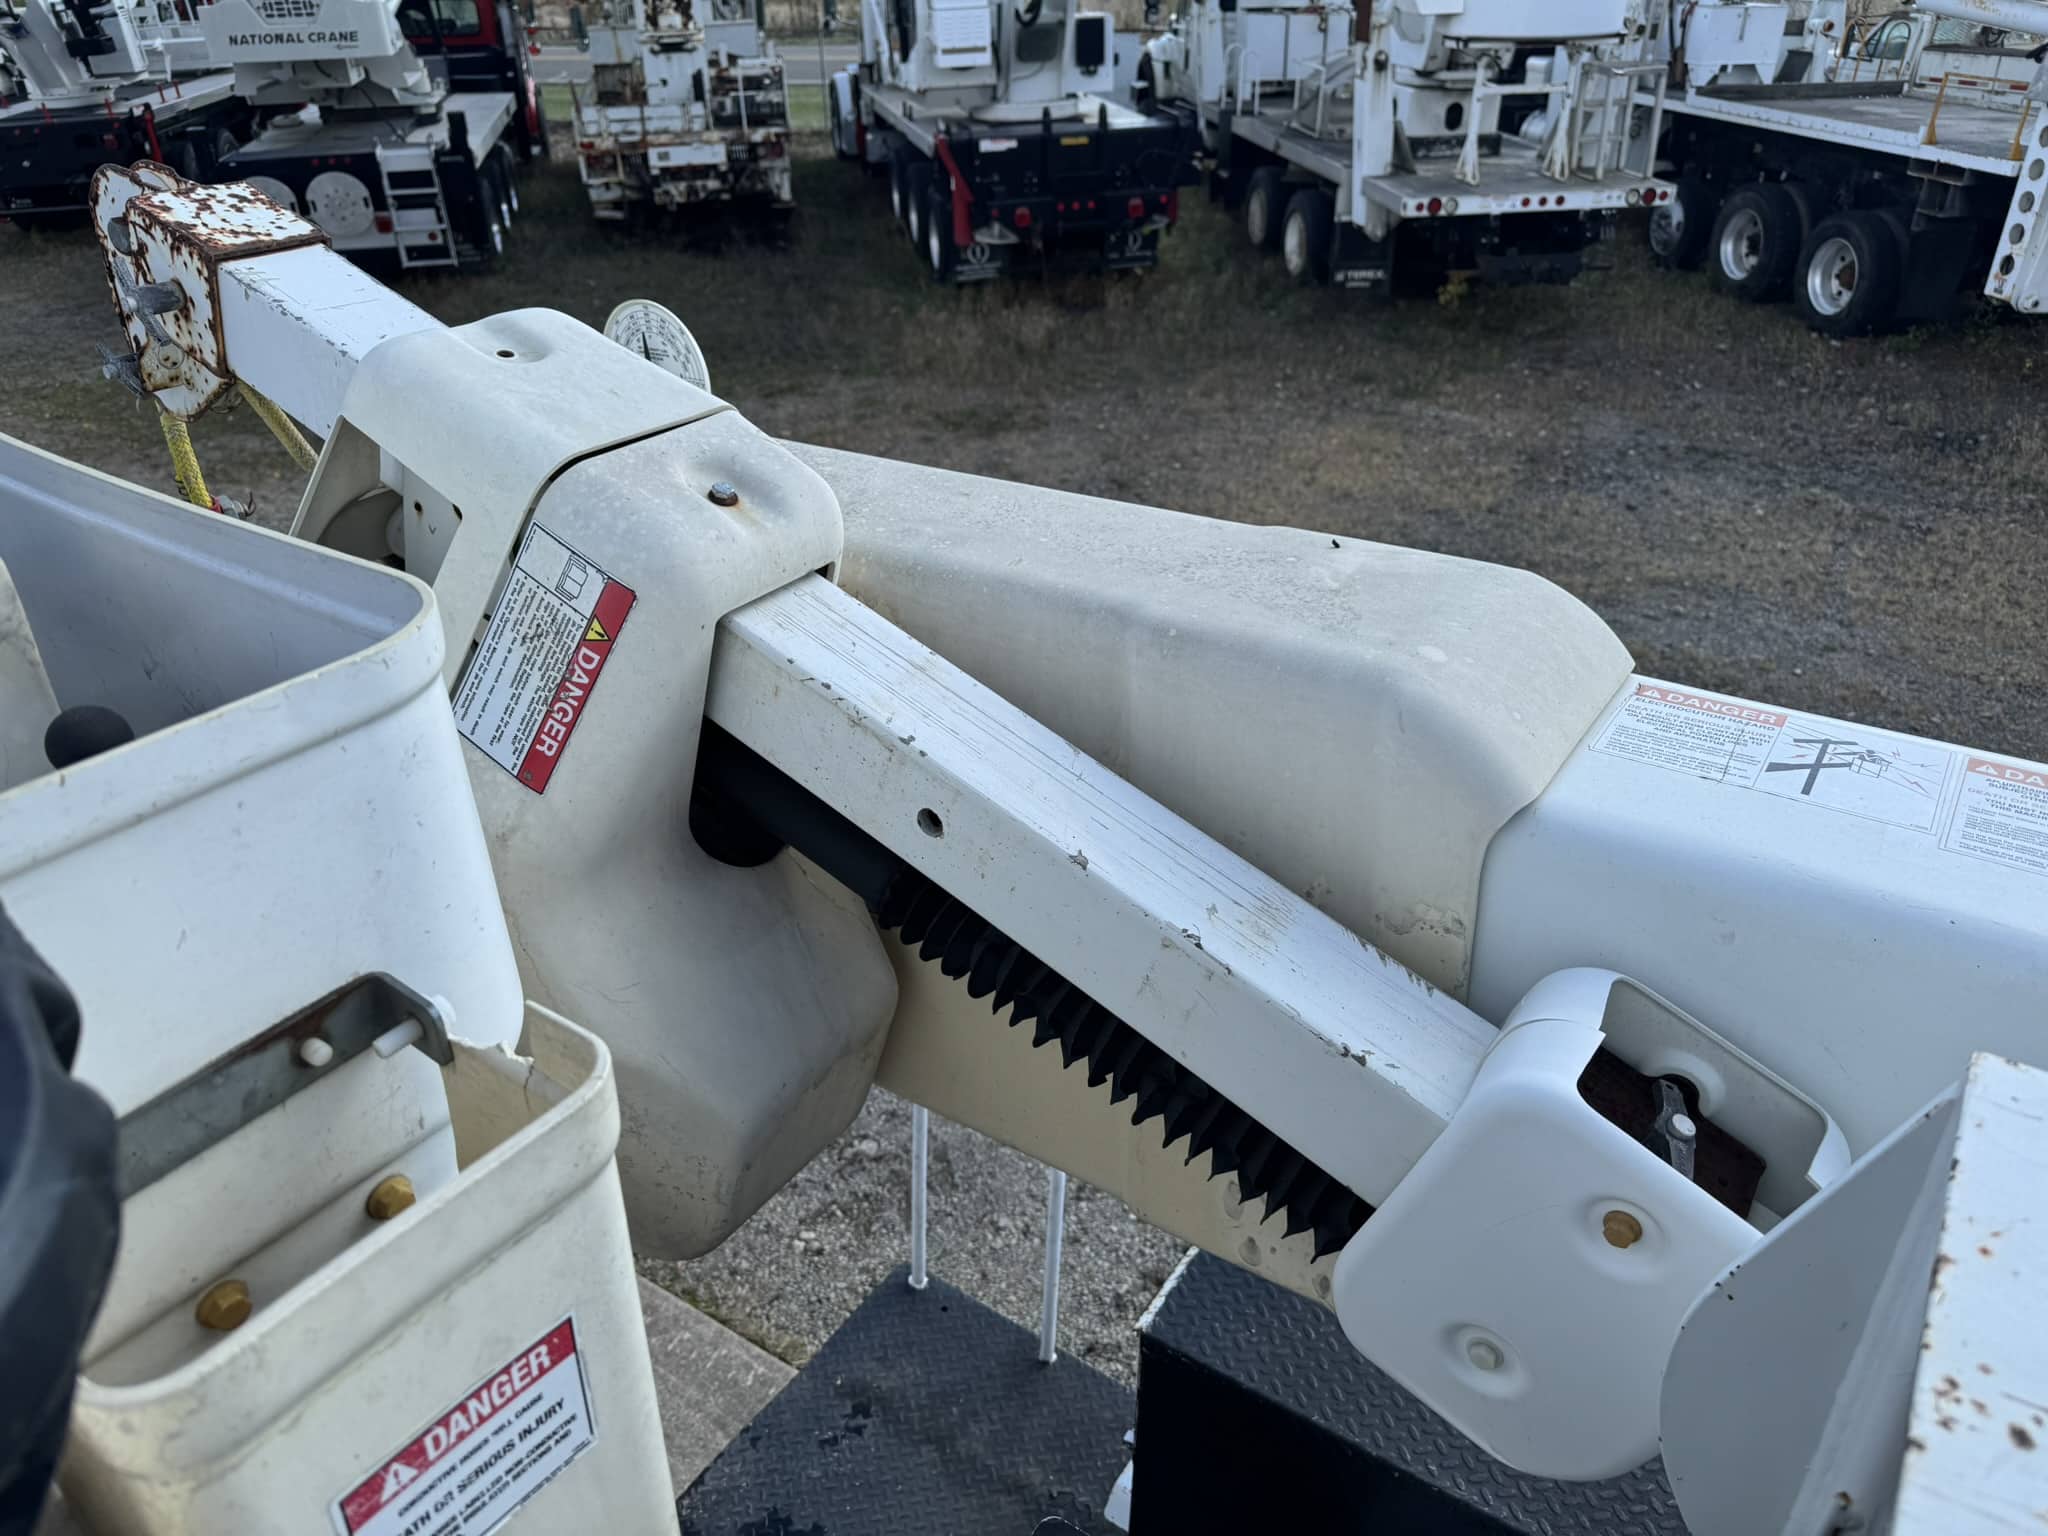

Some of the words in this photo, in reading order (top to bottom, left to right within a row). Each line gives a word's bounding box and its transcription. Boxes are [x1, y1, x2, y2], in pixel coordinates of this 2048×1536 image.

[229, 33, 304, 46] NATIONAL
[308, 31, 358, 43] CRANE
[535, 643, 600, 759] DANGER
[1626, 703, 1663, 715] DEATH
[1682, 715, 1730, 730] SERIOUS
[1635, 696, 1725, 720] ELECTROCUTION
[1728, 717, 1775, 731] HAZARD
[1665, 693, 1776, 724] DANGER
[420, 1339, 551, 1462] DANGER
[396, 1462, 458, 1519] CONDUCTIVE
[458, 1435, 490, 1467] HOSES
[514, 1390, 544, 1421] CAUSE
[402, 1511, 431, 1536] ATH
[432, 1487, 455, 1515] OR
[455, 1436, 516, 1495] SERIOUS
[517, 1395, 565, 1444] INJURY
[503, 1411, 577, 1479] NON-CONDUCTIVE
[511, 1442, 552, 1483] SECTIONS
[553, 1426, 571, 1447] AND
